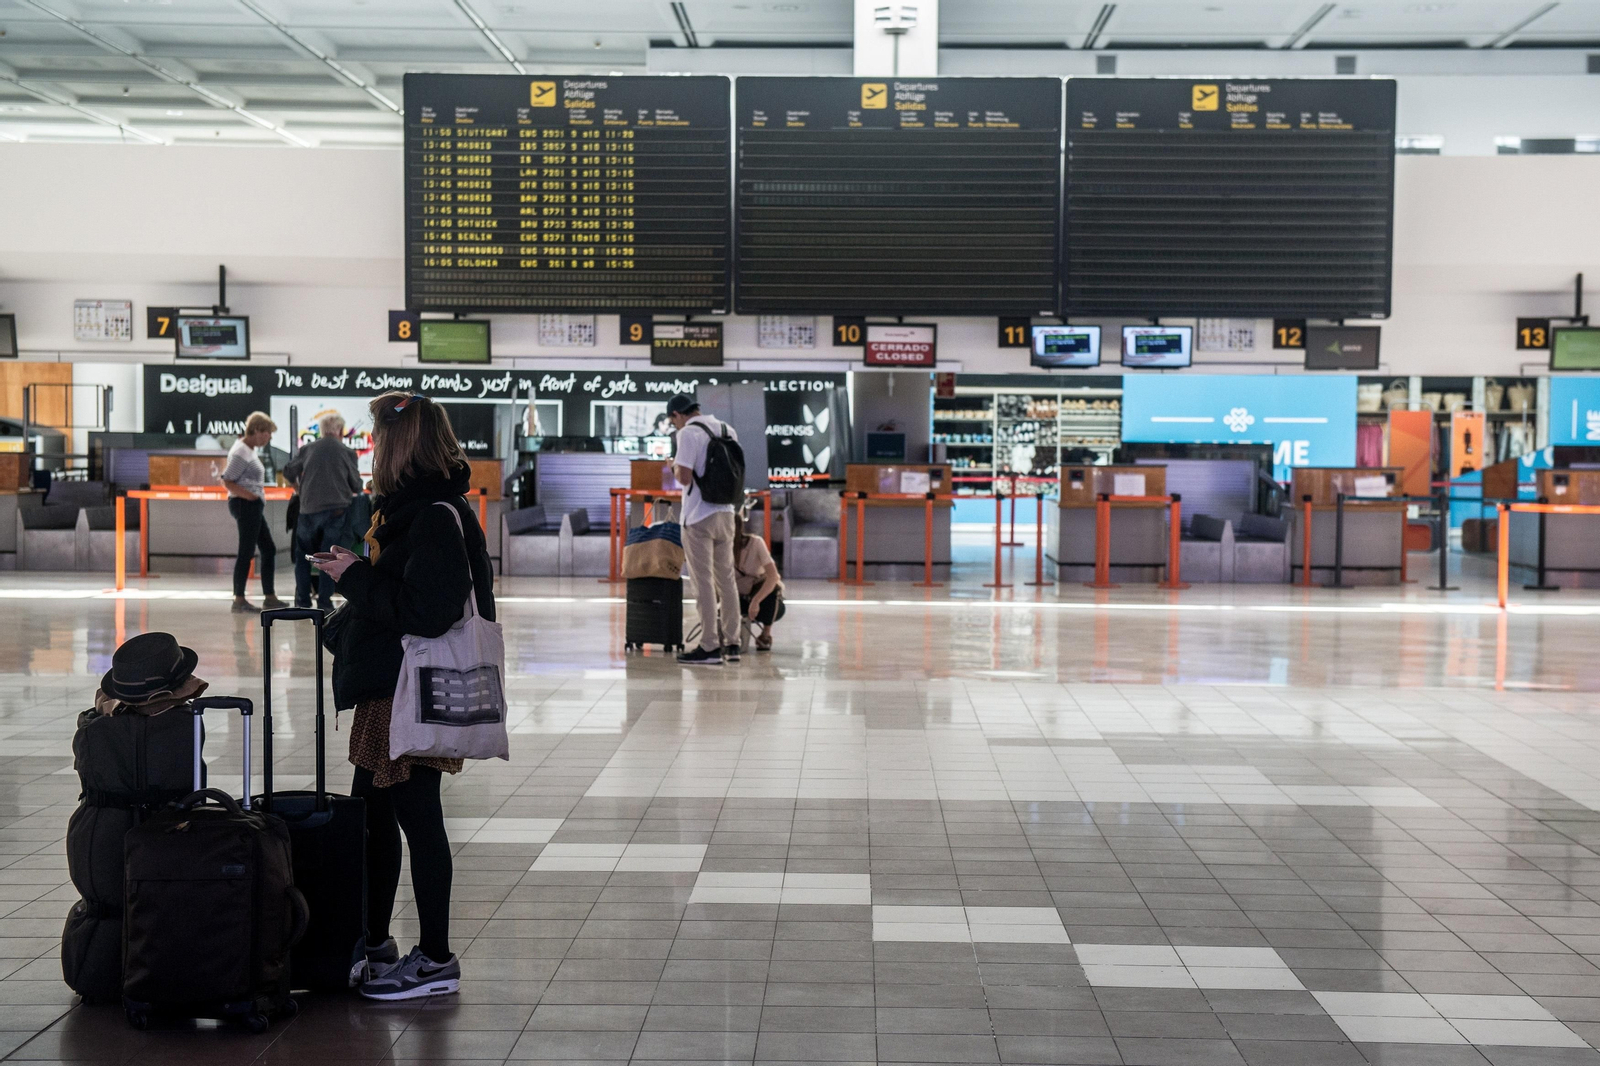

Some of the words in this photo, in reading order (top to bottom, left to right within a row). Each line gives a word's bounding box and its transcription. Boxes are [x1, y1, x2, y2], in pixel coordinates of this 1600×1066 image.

[564, 100, 595, 108] Salidas
[895, 101, 926, 110] Salidas
[1226, 103, 1258, 112] Salidas
[423, 128, 452, 137] 11:50
[456, 128, 508, 138] STUTTGART
[605, 130, 635, 139] 11:20
[423, 140, 452, 150] 13:45
[456, 141, 492, 150] MADRID
[605, 142, 634, 152] 13:15
[423, 153, 452, 163] 13:45
[456, 154, 492, 164] MADRID
[605, 155, 634, 165] 13:15
[423, 167, 452, 176] 13:45
[456, 167, 492, 177] MADRID
[605, 168, 634, 178] 13:15
[423, 179, 452, 189] 13:45
[456, 180, 492, 190] MADRID
[605, 181, 634, 191] 13:15
[423, 192, 452, 202] 13:45
[456, 193, 493, 203] MADRID
[605, 194, 634, 204] 13:15
[423, 205, 452, 215] 13:45
[456, 206, 493, 215] MADRID
[606, 207, 634, 217] 13:15
[423, 218, 453, 228] 14:00
[457, 218, 498, 228] GATWICK
[606, 220, 635, 230] 13:30
[423, 231, 452, 241] 15:45
[457, 232, 493, 241] BERLIN
[606, 233, 634, 243] 15:15
[423, 244, 453, 255] 16:00
[457, 245, 504, 255] HAMBURGO
[424, 257, 453, 267] 16:05
[457, 258, 499, 268] COLONIA
[157, 317, 170, 336] 7
[398, 320, 411, 339] 8
[629, 323, 643, 342] 9
[837, 325, 860, 343] 10
[1004, 326, 1025, 344] 11
[1277, 327, 1302, 346] 12
[1520, 328, 1546, 347] 13
[654, 339, 719, 348] STUTTGART
[871, 343, 930, 352] CERRADO
[876, 353, 924, 361] CLOSED
[275, 369, 303, 389] The
[311, 369, 348, 390] best
[355, 370, 413, 390] fashion
[421, 374, 473, 392] brands
[478, 371, 512, 398] just
[519, 378, 532, 390] in
[583, 375, 602, 392] of
[601, 373, 638, 398] gate
[645, 379, 699, 394] number
[205, 420, 247, 434] ARMAN
[764, 424, 815, 436] ARIENSIS
